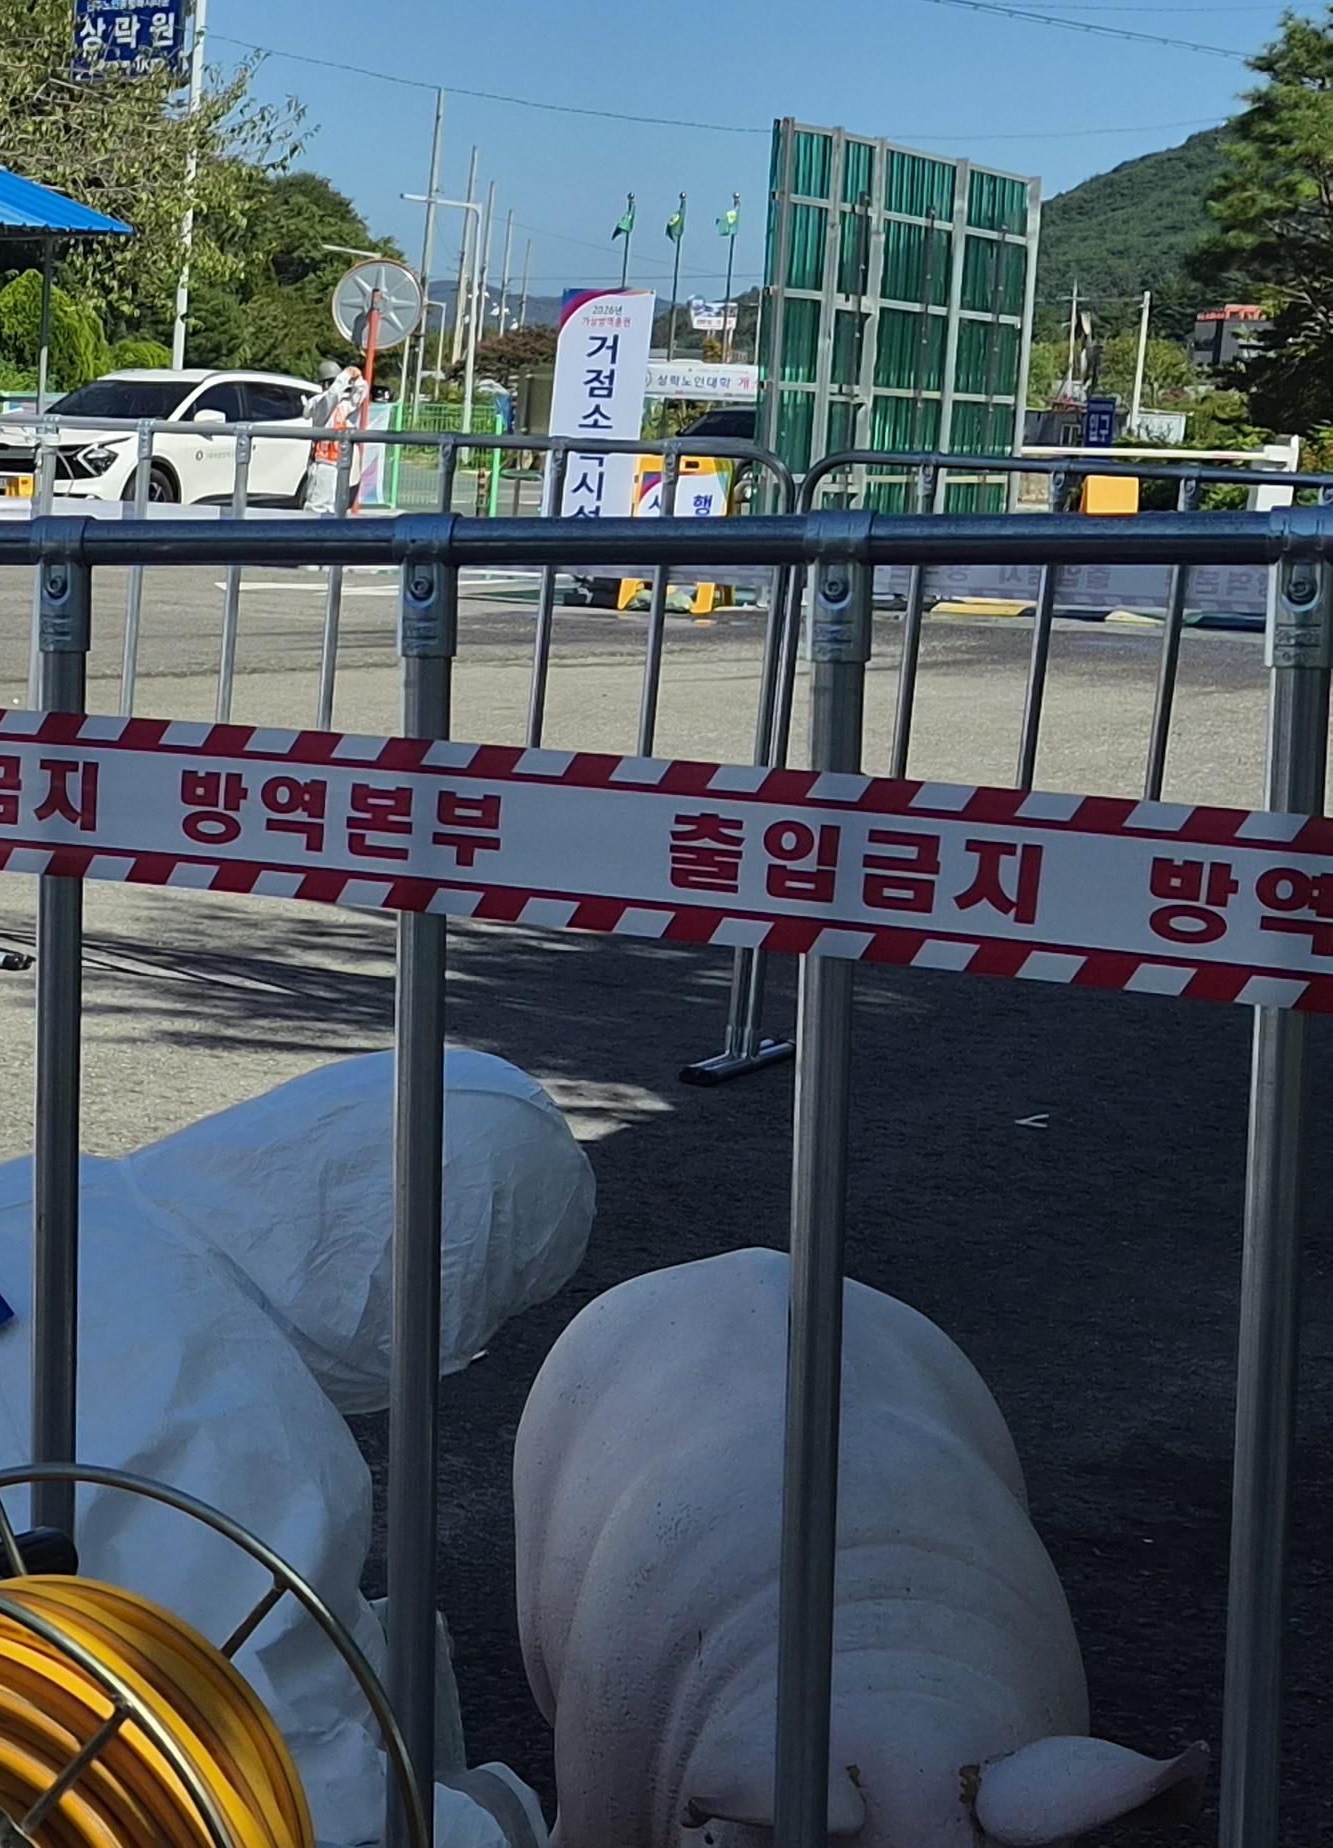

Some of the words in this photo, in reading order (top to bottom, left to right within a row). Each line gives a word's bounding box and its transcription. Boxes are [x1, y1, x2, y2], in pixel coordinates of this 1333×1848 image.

[79, 12, 175, 51] 상락원
[592, 305, 623, 316] 2026년
[180, 768, 502, 867] 방역본부
[668, 812, 1044, 925] 출입금지
[1149, 857, 1333, 956] 방역
